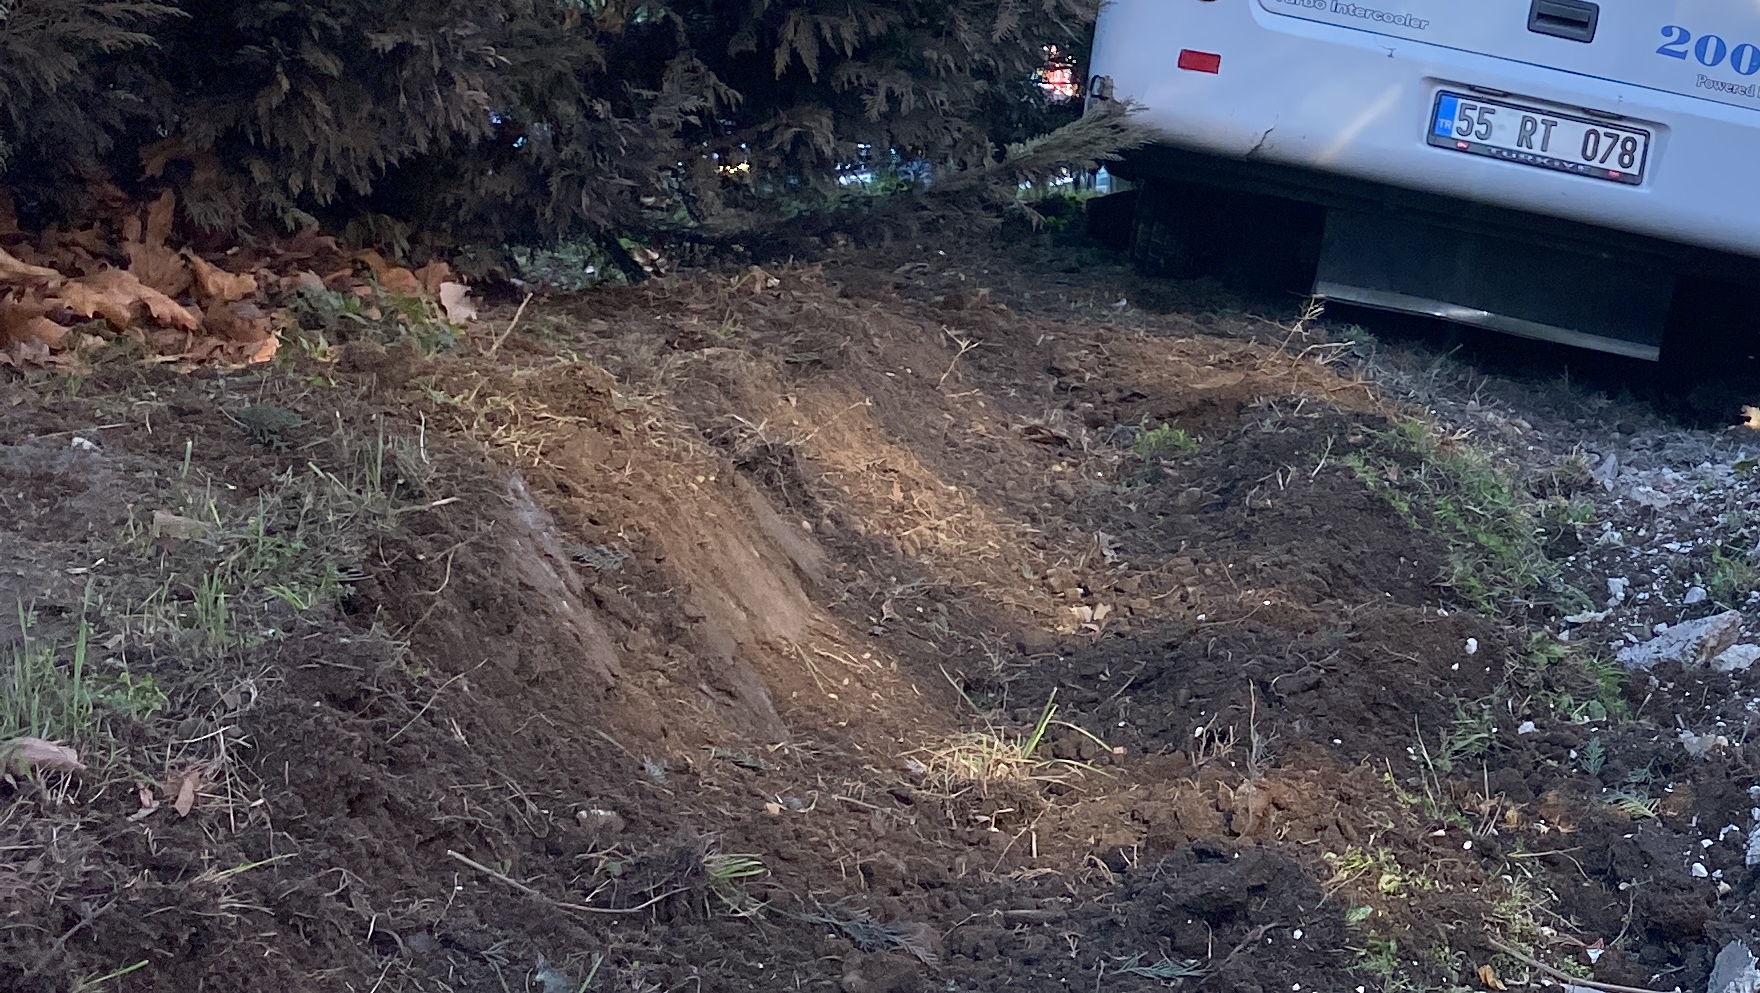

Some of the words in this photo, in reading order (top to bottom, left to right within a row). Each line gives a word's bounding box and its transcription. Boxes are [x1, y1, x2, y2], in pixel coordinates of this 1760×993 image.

[1696, 74, 1756, 98] Powered
[1439, 118, 1453, 129] TR
[1455, 103, 1496, 141] 55
[1516, 115, 1558, 153] RT
[1580, 128, 1638, 169] 078
